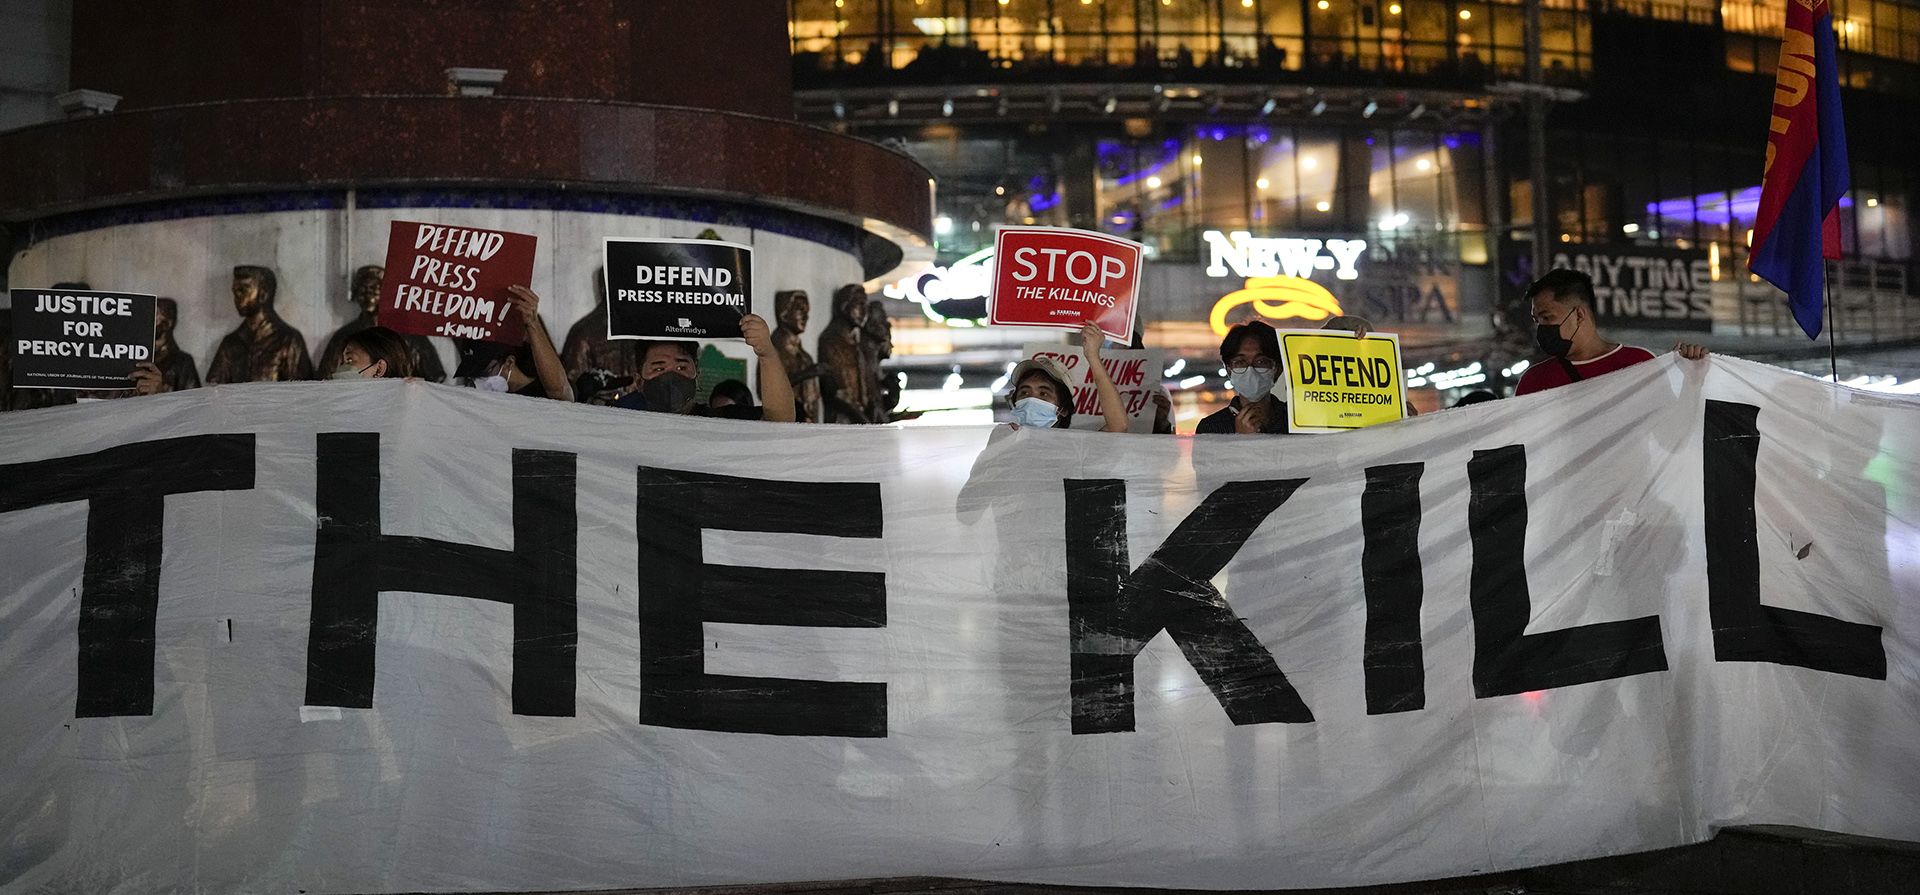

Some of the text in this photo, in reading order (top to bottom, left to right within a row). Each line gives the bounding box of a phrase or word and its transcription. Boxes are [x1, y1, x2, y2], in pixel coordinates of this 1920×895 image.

[414, 224, 504, 261] DEFEND
[410, 255, 480, 292] PRESS
[636, 265, 732, 287] DEFEND
[1011, 247, 1126, 289] STOP
[34, 294, 132, 316] JUSTICE
[617, 289, 744, 306] PRESS FREEDOM!
[1016, 286, 1116, 308] THE KILLINGS
[1594, 287, 1713, 320] TNESS
[63, 321, 103, 337] FOR
[665, 325, 707, 335] Altermidya
[18, 340, 149, 360] PERCY LAPID
[1298, 354, 1391, 388] DEFEND
[1303, 391, 1392, 405] PRESS FREEDOM
[0, 398, 1887, 738] THE KILL
